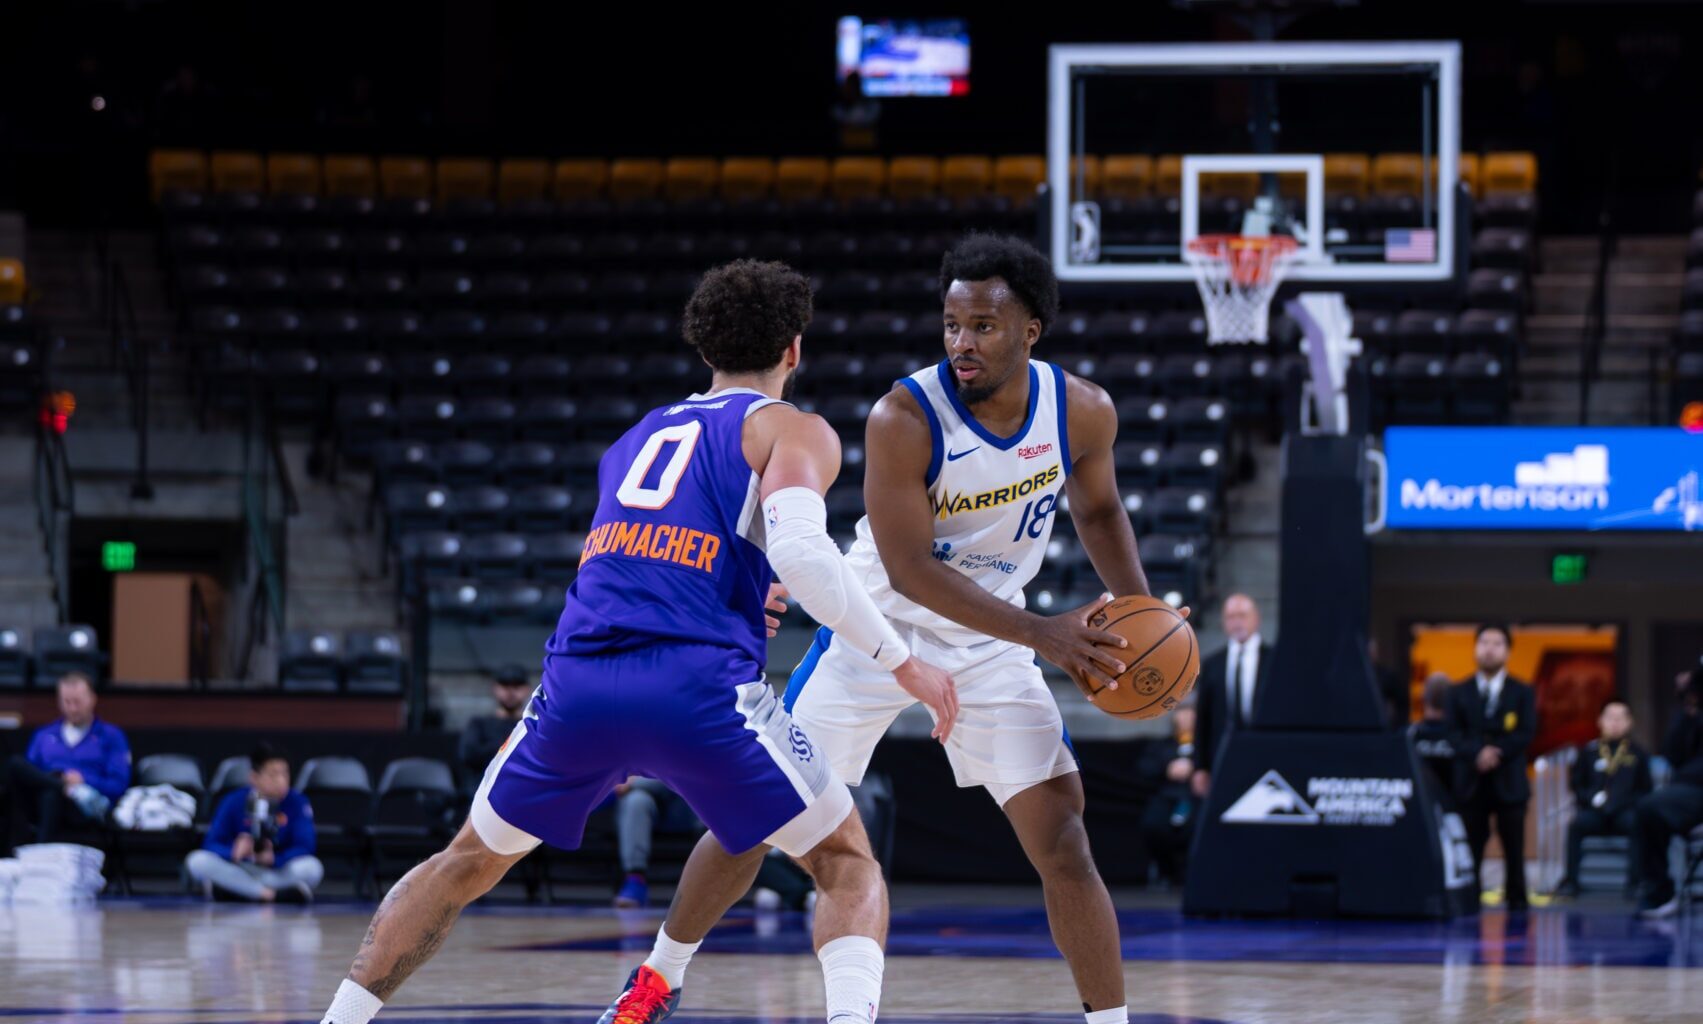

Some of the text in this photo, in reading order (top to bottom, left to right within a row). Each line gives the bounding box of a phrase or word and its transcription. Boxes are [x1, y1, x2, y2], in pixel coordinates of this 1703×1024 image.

[616, 419, 701, 510] 0
[1018, 443, 1052, 459] Rakuten
[933, 464, 1059, 521] WARRIORS
[1401, 479, 1608, 510] Mortenson
[1013, 494, 1057, 542] 18
[1308, 778, 1412, 798] MOUNTAIN
[1314, 796, 1406, 816] AMERICA
